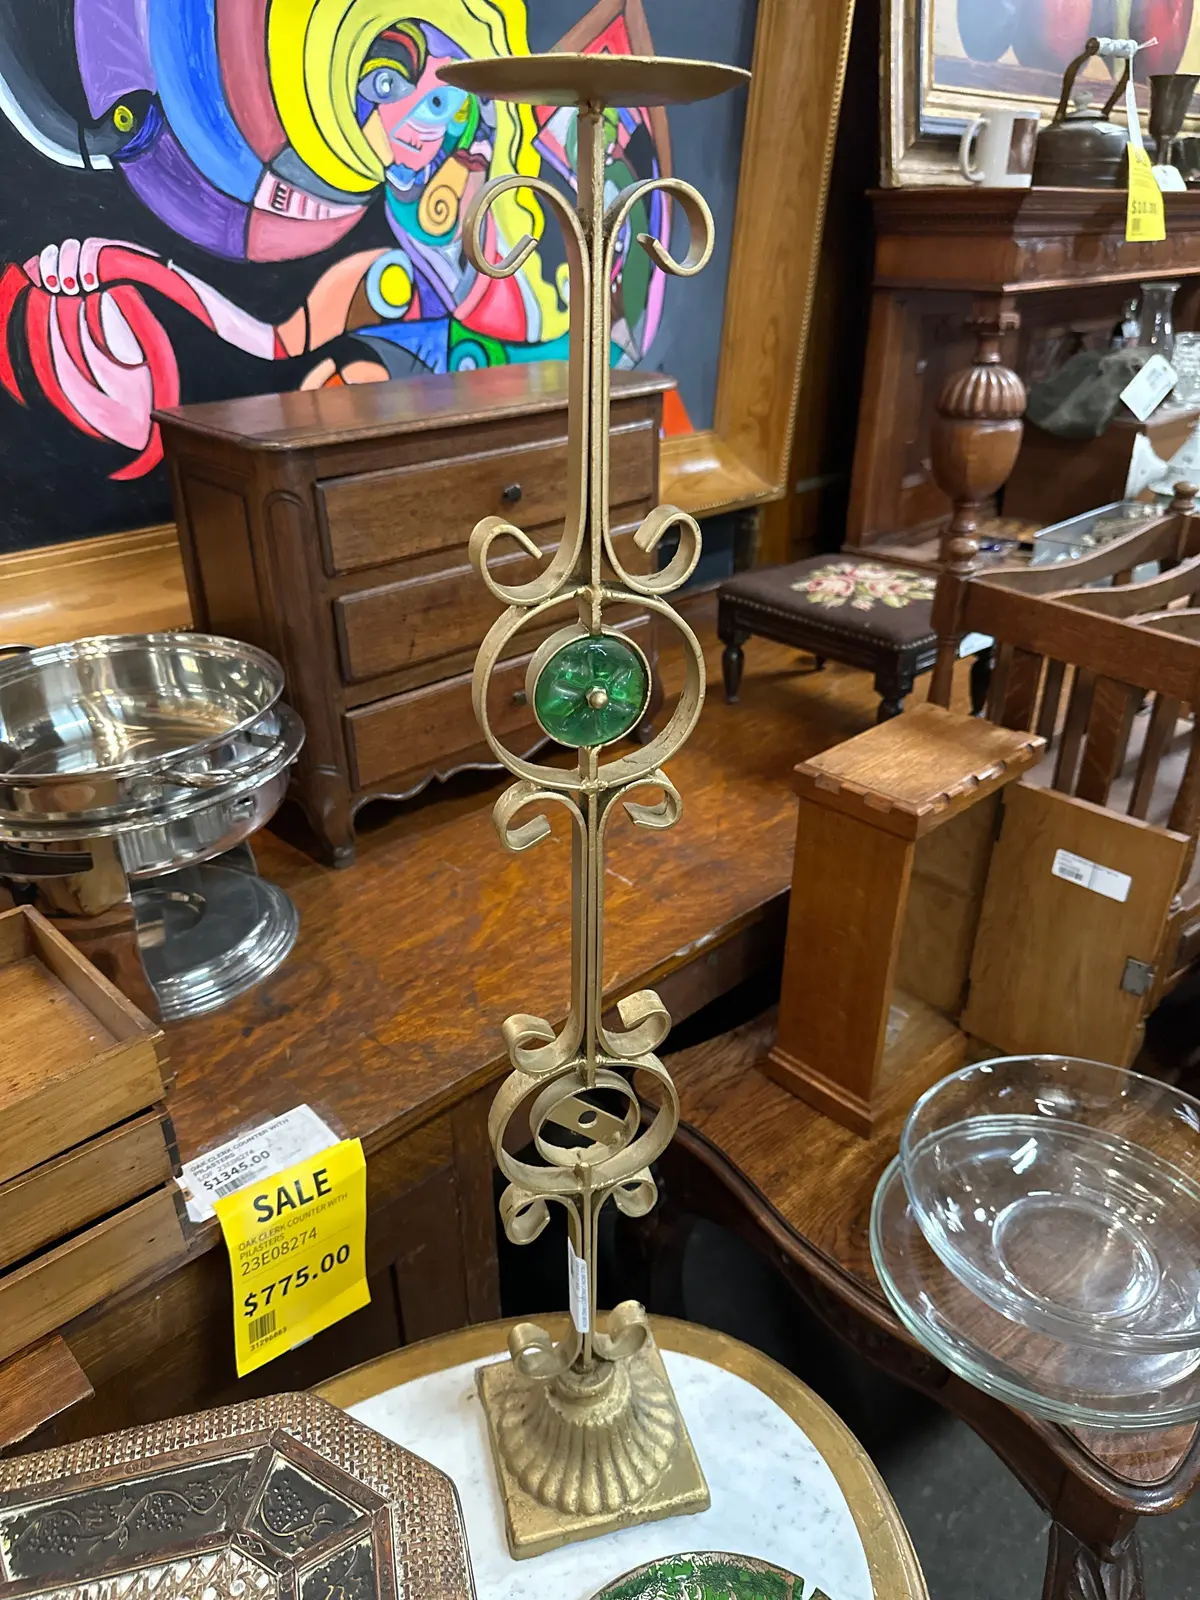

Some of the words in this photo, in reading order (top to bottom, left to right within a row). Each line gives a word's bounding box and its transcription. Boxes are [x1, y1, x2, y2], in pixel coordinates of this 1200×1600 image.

[232, 1128, 268, 1149] COUNTER
[269, 1118, 290, 1131] WITH
[193, 1152, 236, 1177] PILASTERS
[203, 1150, 270, 1191] $1345.00
[253, 1168, 332, 1223] SALE
[238, 1236, 259, 1251] OAK
[258, 1223, 286, 1241] CLERK
[287, 1204, 328, 1228] COUNTER
[327, 1193, 348, 1208] WITH
[240, 1233, 285, 1260] PILASTERS
[241, 1227, 317, 1276] 23E08274
[244, 1244, 350, 1317] $775.00
